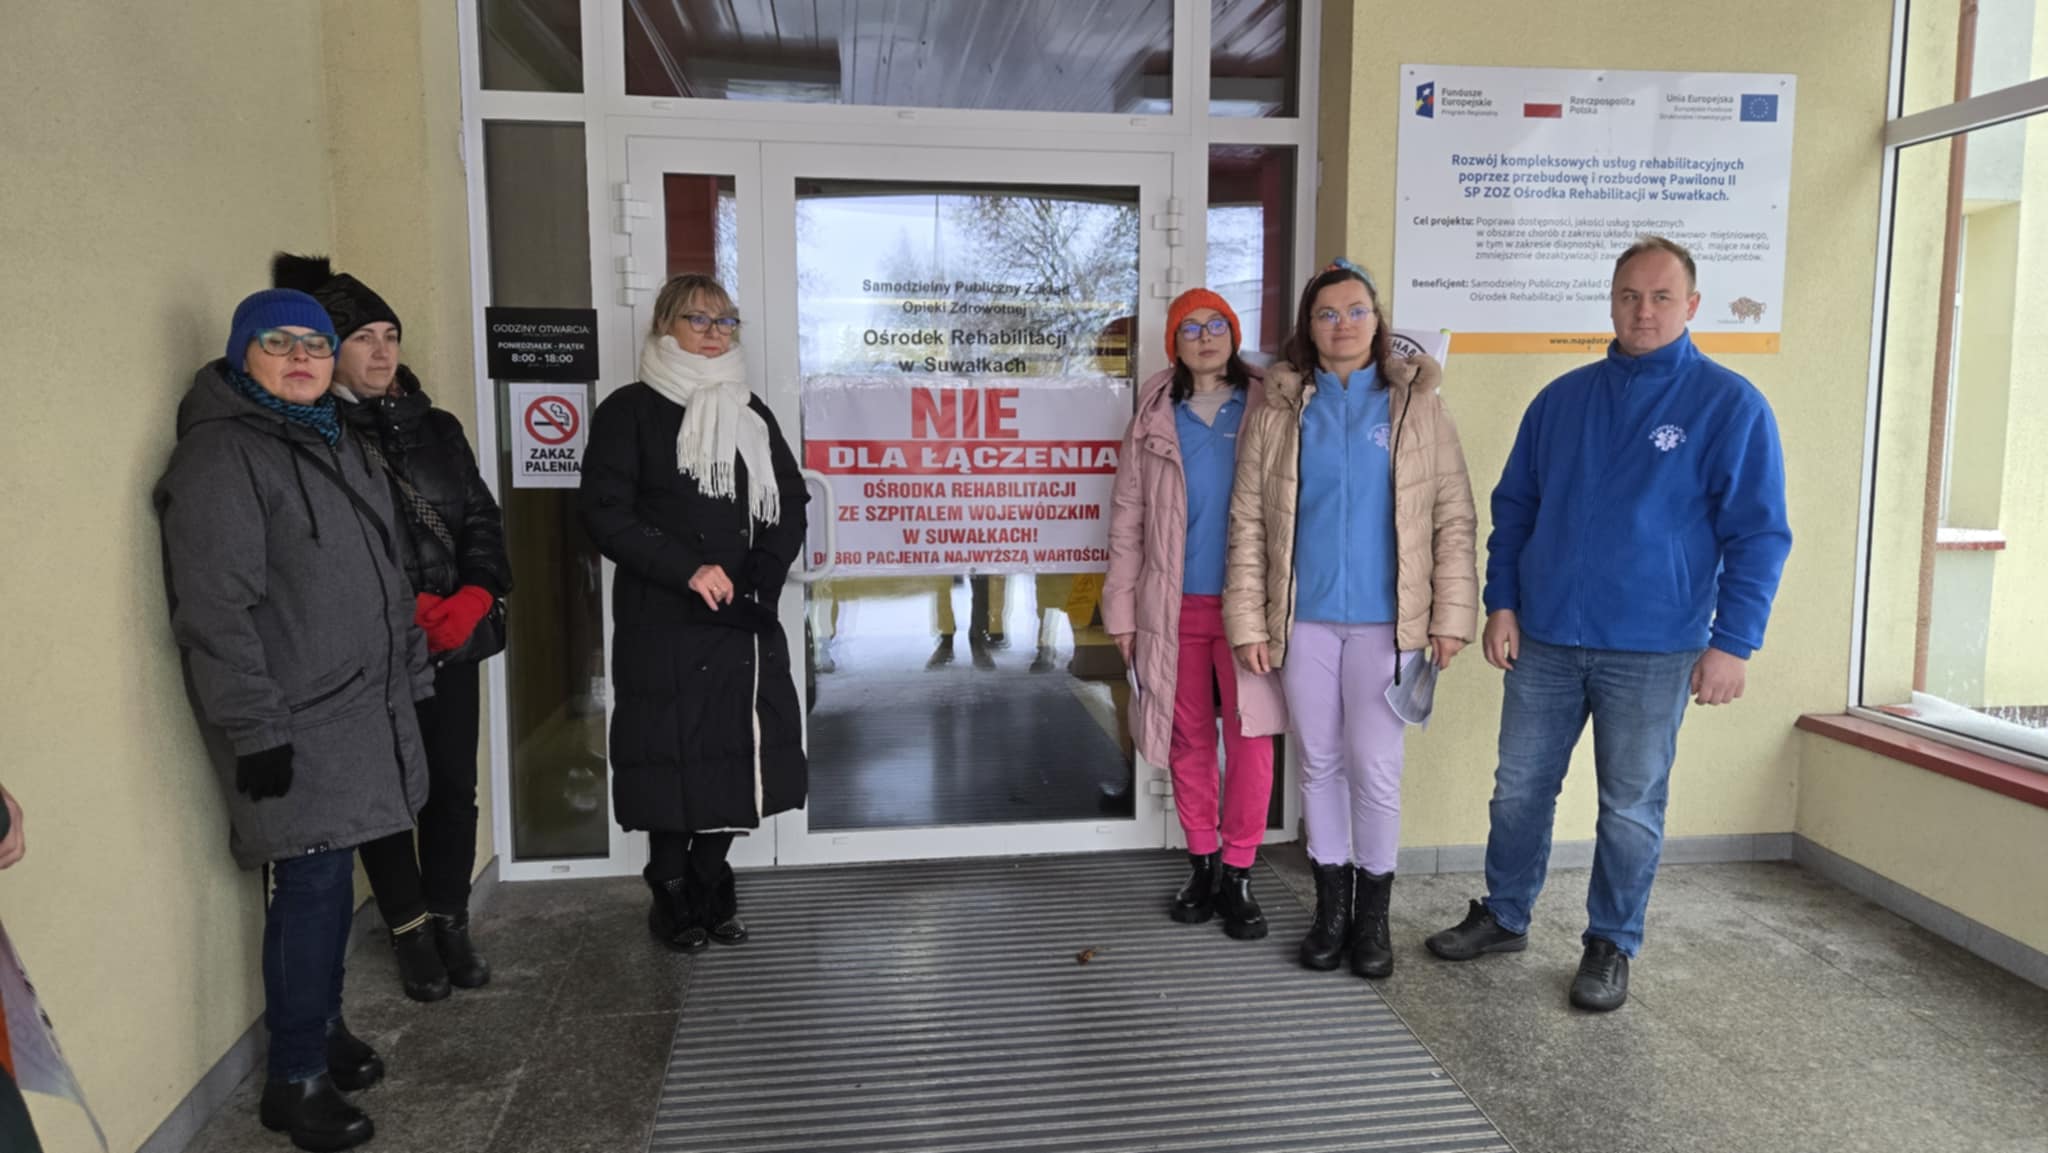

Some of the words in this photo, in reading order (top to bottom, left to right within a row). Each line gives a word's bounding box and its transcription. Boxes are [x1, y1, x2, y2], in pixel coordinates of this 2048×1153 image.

[1441, 88, 1483, 98] Fundusze
[1441, 98, 1493, 108] Europejskie
[1569, 96, 1635, 107] Rzeczpospolita
[1667, 94, 1686, 103] Unia
[1688, 94, 1734, 105] Europejska
[1569, 106, 1598, 115] Polska
[1452, 153, 1497, 169] Rozwój
[1501, 154, 1600, 170] kompleksowych
[1603, 157, 1637, 171] usług
[1640, 157, 1744, 172] rehabilitacyjnych
[1459, 171, 1510, 184] poprzez
[1513, 170, 1588, 186] przebudowę
[1591, 171, 1595, 183] i
[1598, 172, 1666, 187] rozbudowę
[1670, 173, 1725, 186] Pawilonu
[1728, 174, 1736, 186] II
[1464, 187, 1480, 198] SP
[1484, 187, 1511, 198] ZOZ
[1513, 186, 1566, 199] Ośrodka
[1569, 187, 1646, 203] Rehabilitacji
[1648, 191, 1658, 200] w
[1661, 188, 1730, 201] Suwałkach.
[1413, 216, 1429, 226] Cel
[1431, 216, 1475, 228] projektu:
[1476, 217, 1515, 228] Poprawa
[1575, 217, 1605, 229] jakości
[1606, 218, 1630, 229] usług
[1632, 218, 1685, 230] społecznych
[1486, 228, 1526, 238] obszarze
[1528, 228, 1559, 238] chorób
[1567, 229, 1601, 238] zakresu
[1603, 229, 1633, 239] układu
[1486, 240, 1504, 250] tym
[1515, 240, 1551, 249] zakresie
[1708, 242, 1739, 251] mające
[1752, 241, 1770, 250] celu
[1475, 251, 1533, 261] zmniejszenie
[1535, 251, 1597, 262] dezaktywizacji
[862, 279, 950, 295] Samodzielny
[954, 280, 1020, 296] Publiczny
[1412, 278, 1469, 289] Beneficjent:
[1470, 279, 1527, 290] Samodzielny
[1528, 279, 1570, 290] Publiczny
[1572, 279, 1602, 289] Zakład
[1470, 291, 1507, 301] Ośrodek
[1510, 292, 1563, 302] Rehabilitacji
[902, 300, 947, 315] Opieki
[950, 301, 1027, 317] Zdrowotnej
[492, 324, 537, 333] GODZINY
[863, 329, 944, 345] Ośrodek
[951, 329, 1067, 349] Rehabilitacji
[497, 342, 553, 350] PONIEDZIAŁEK
[559, 343, 585, 351] PIĄTEK
[511, 353, 537, 362] 8:00
[544, 353, 574, 363] 18:00
[898, 360, 914, 373] w
[923, 356, 1026, 373] Suwałkach
[911, 387, 1019, 439] NIE
[530, 448, 575, 460] ZAKAZ
[828, 447, 908, 468] DLA
[921, 446, 1119, 474] ŁĄCZENIA
[525, 461, 581, 472] PALENIA
[864, 478, 946, 498] OŚRODKA
[951, 481, 1076, 498] REHABILITACJI
[838, 505, 860, 522] ZE
[865, 505, 963, 522] SZPITALEM
[968, 502, 1100, 521] WOJEWÓDZKIM
[903, 529, 920, 544] W
[925, 527, 1038, 545] SUWAŁKACH!
[814, 551, 862, 565] DBRO
[866, 551, 940, 565] PACJENTA
[944, 548, 1029, 564] NAJWYŻSZĄ
